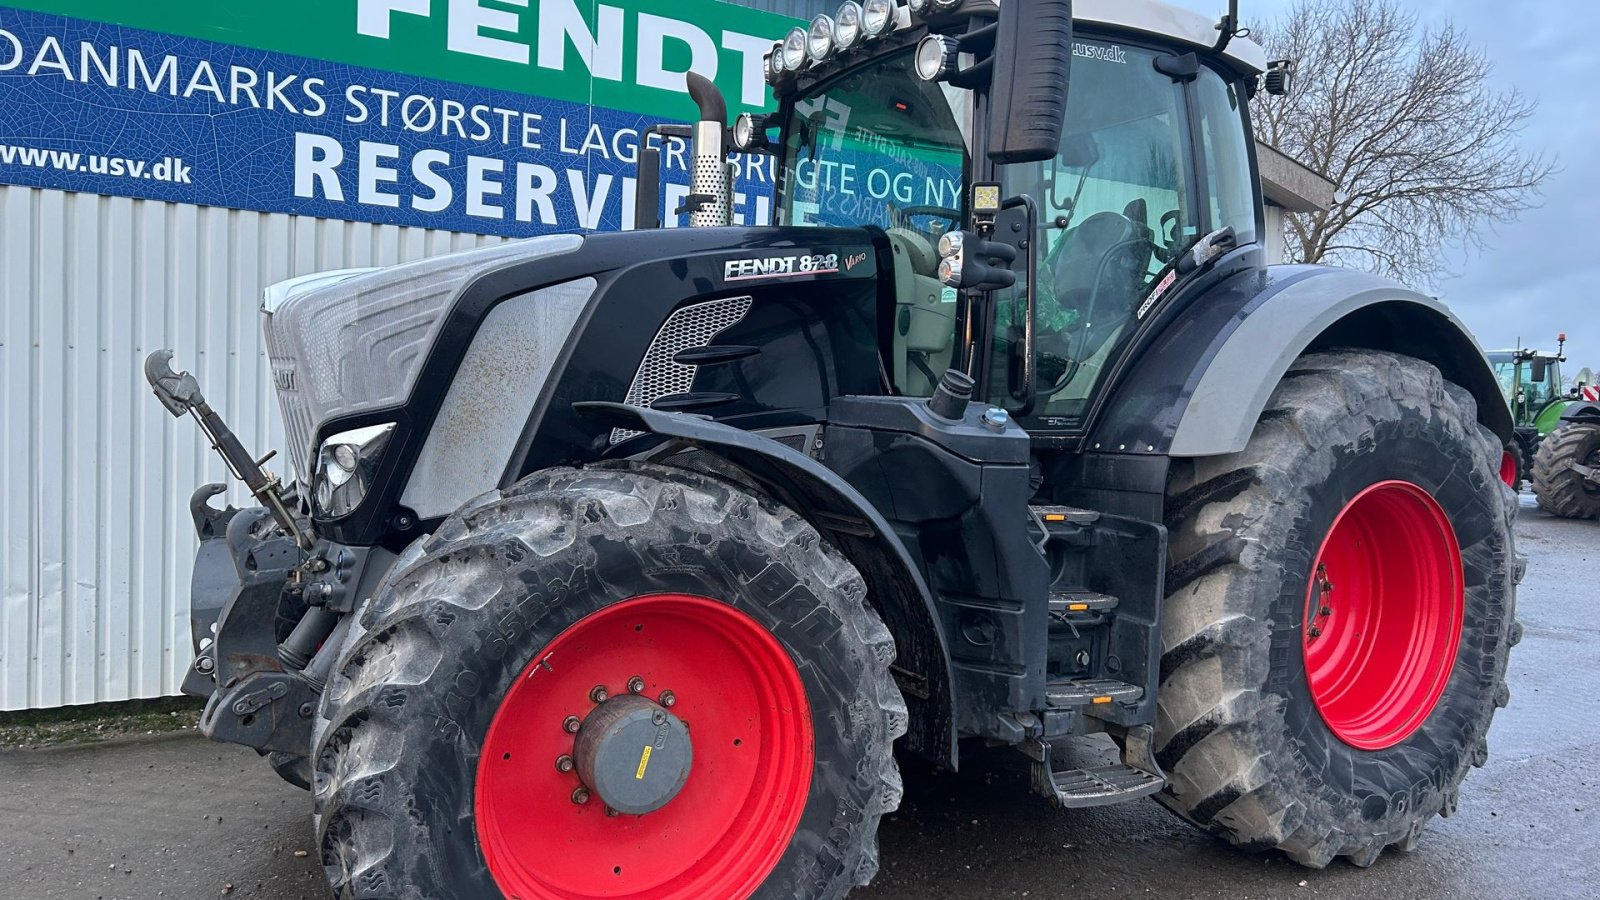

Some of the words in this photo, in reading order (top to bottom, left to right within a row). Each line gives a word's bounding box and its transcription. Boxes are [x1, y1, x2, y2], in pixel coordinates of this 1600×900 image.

[0, 28, 325, 117] DANMARKS
[345, 84, 542, 149] STØRSTE
[867, 168, 913, 203] OG
[0, 144, 192, 184] www.usv.dk
[725, 257, 797, 279] FENDT
[799, 253, 838, 272] 828
